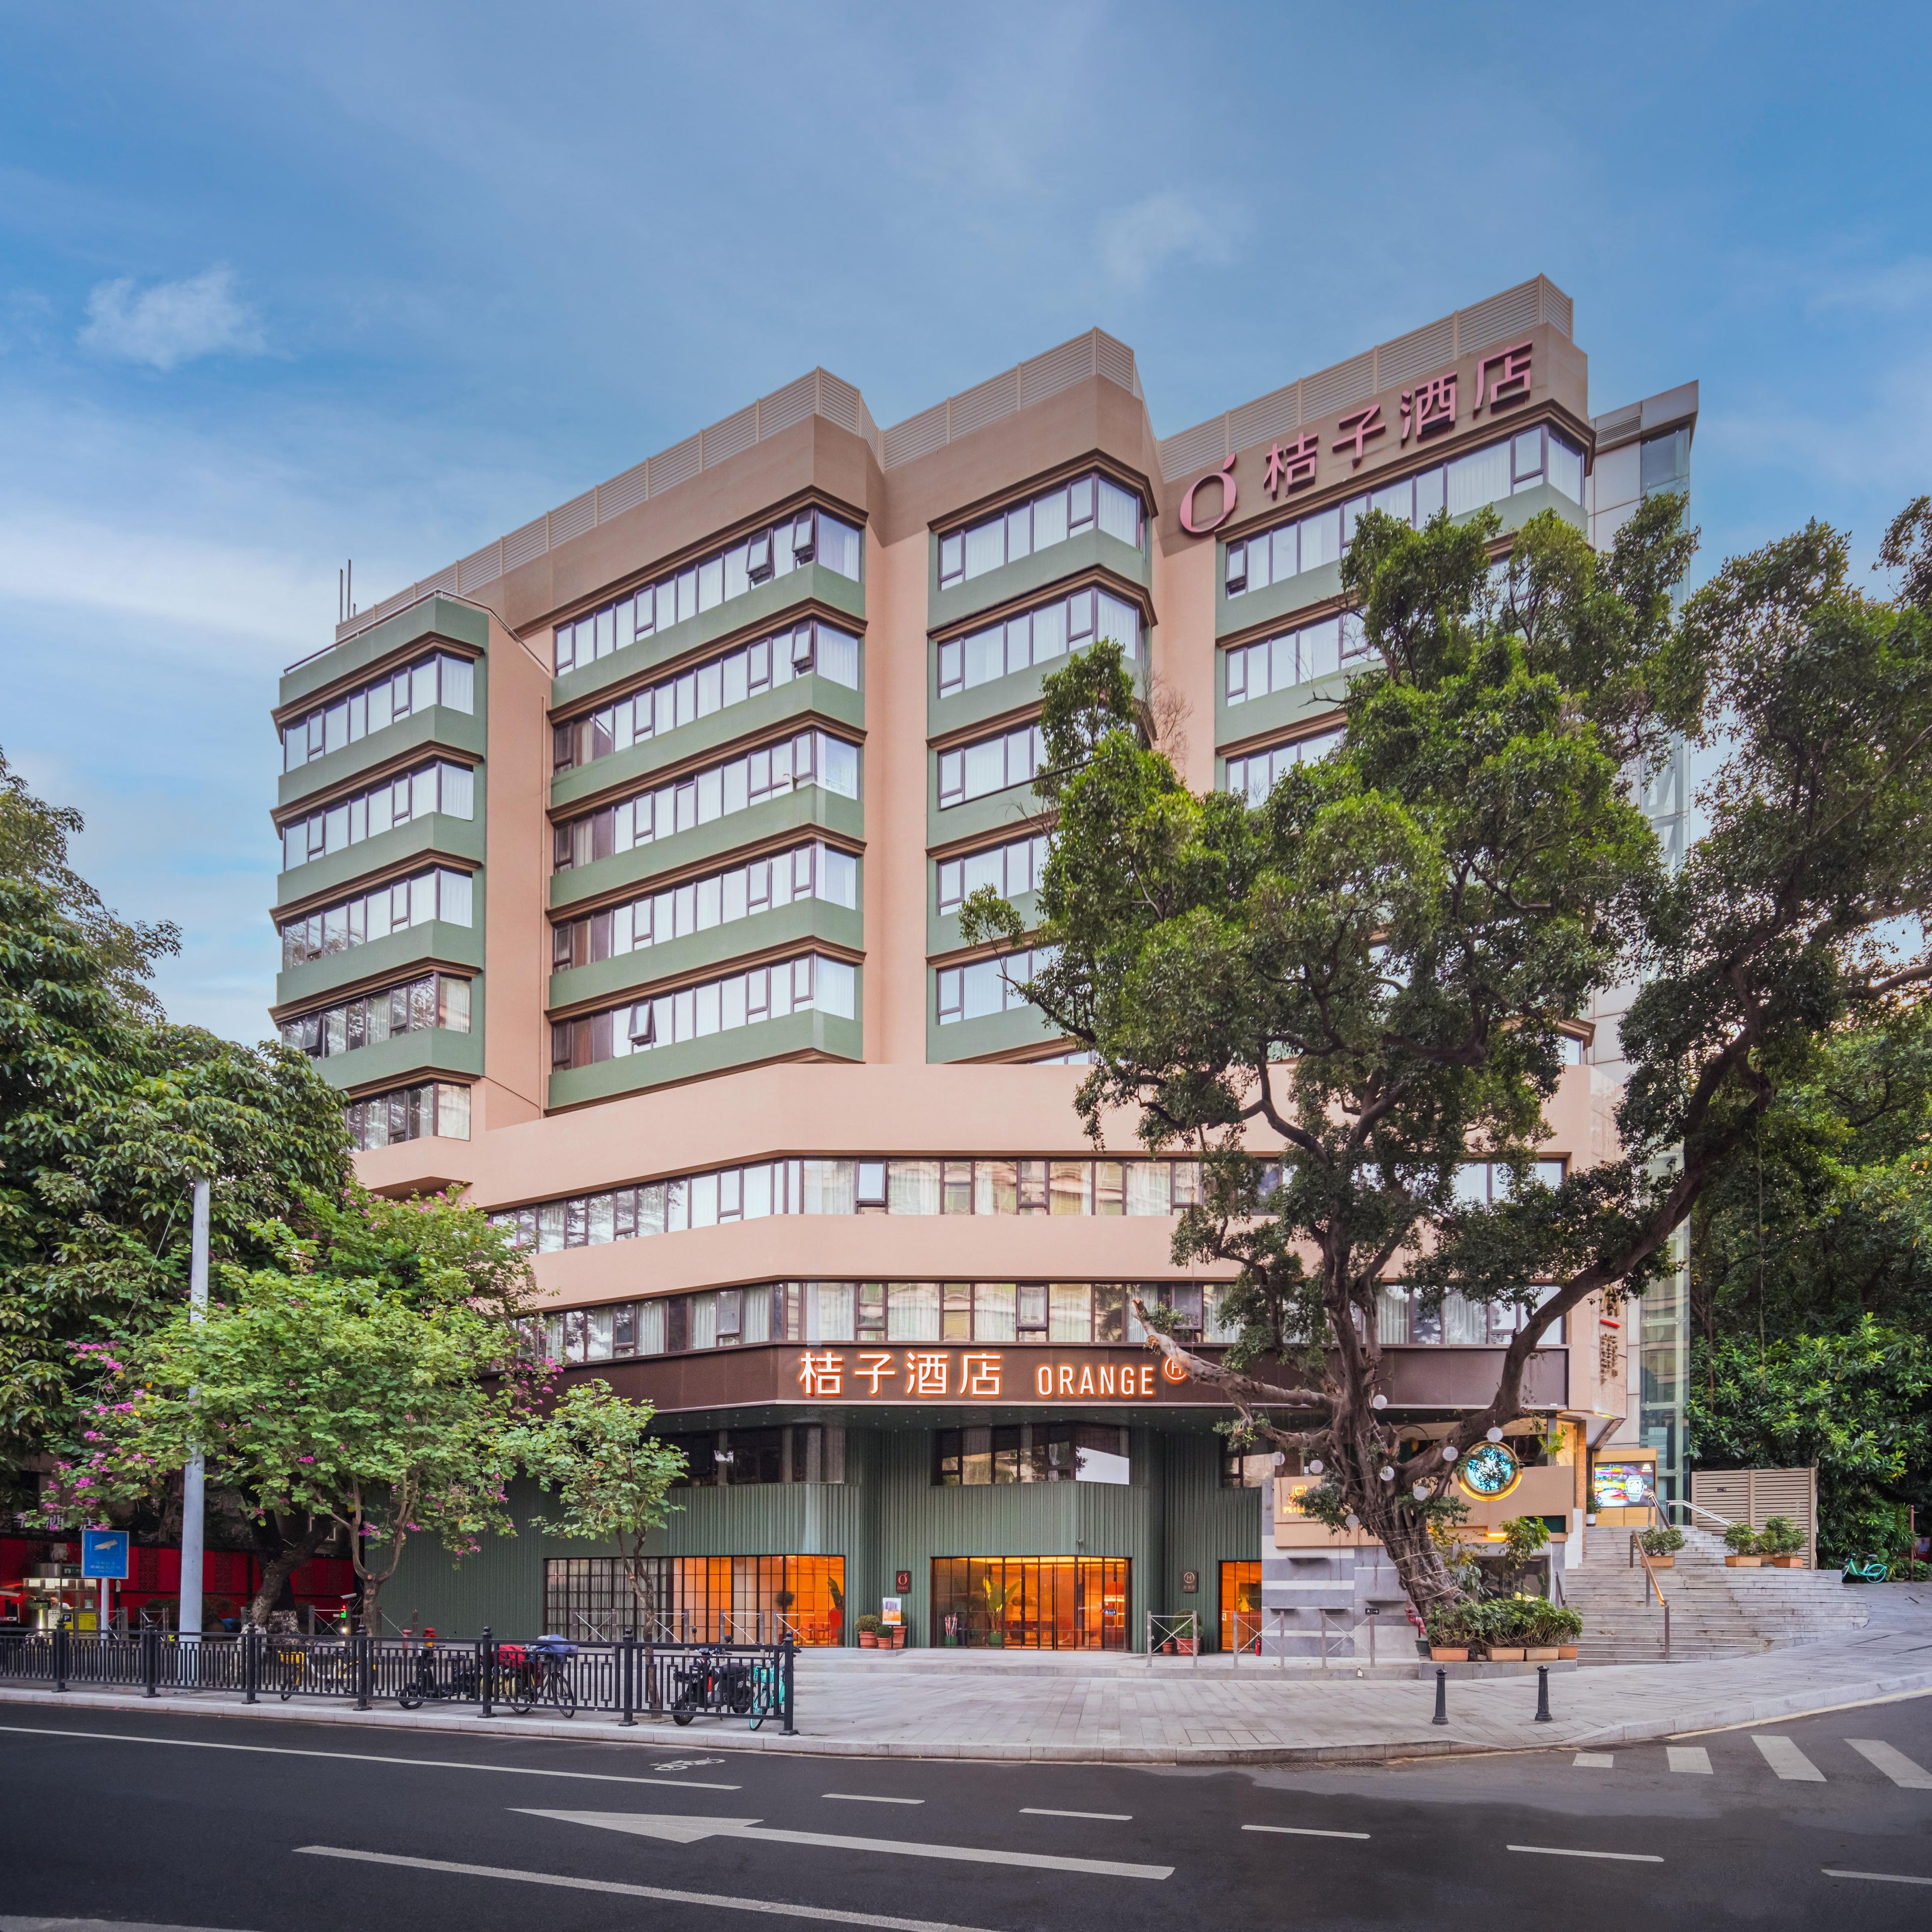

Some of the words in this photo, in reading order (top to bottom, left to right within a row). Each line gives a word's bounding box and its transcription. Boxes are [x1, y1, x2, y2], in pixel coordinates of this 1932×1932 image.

[1264, 340, 1533, 497] 桔子酒店
[799, 1351, 1001, 1395] 桔子酒店
[1037, 1365, 1154, 1396] ORANGE
